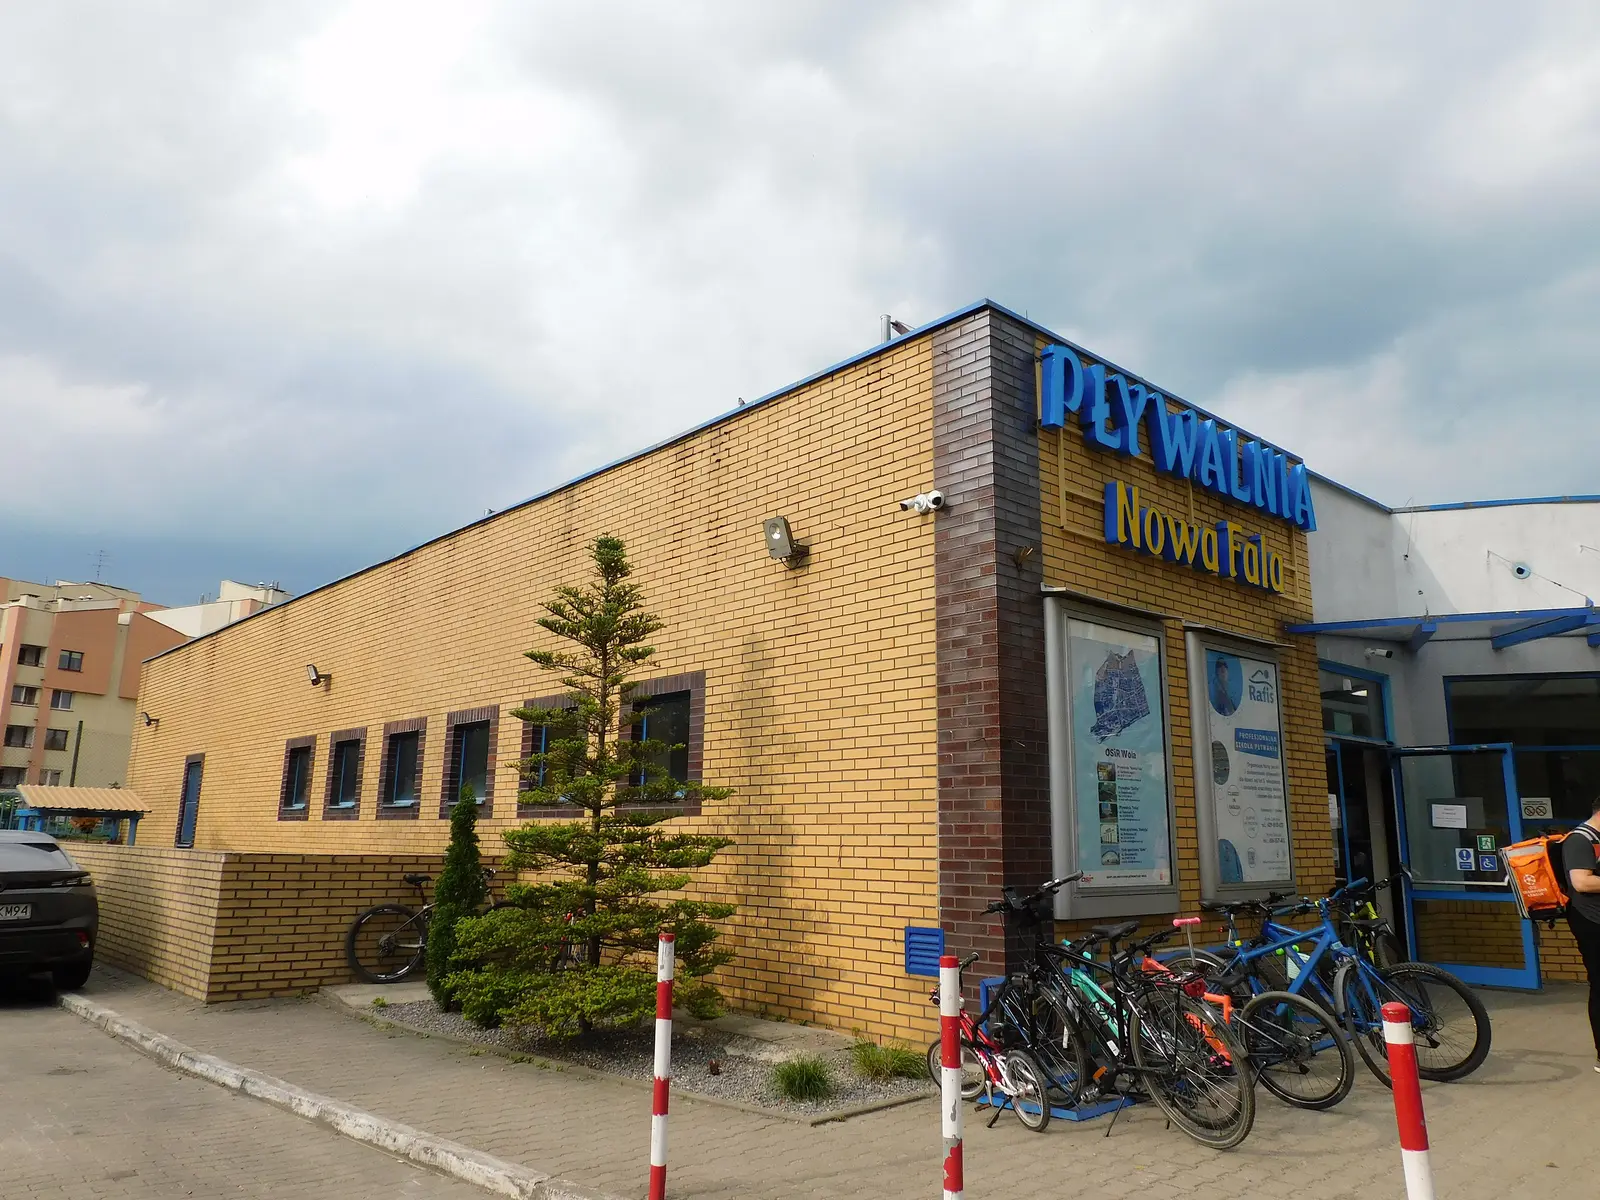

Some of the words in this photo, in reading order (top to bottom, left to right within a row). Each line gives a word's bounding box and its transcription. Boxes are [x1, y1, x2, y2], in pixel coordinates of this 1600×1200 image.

[1041, 343, 1317, 532] PŁYWALNIA
[1105, 480, 1219, 575] Nowa
[1217, 519, 1285, 595] Fala
[1248, 684, 1275, 704] Rafis
